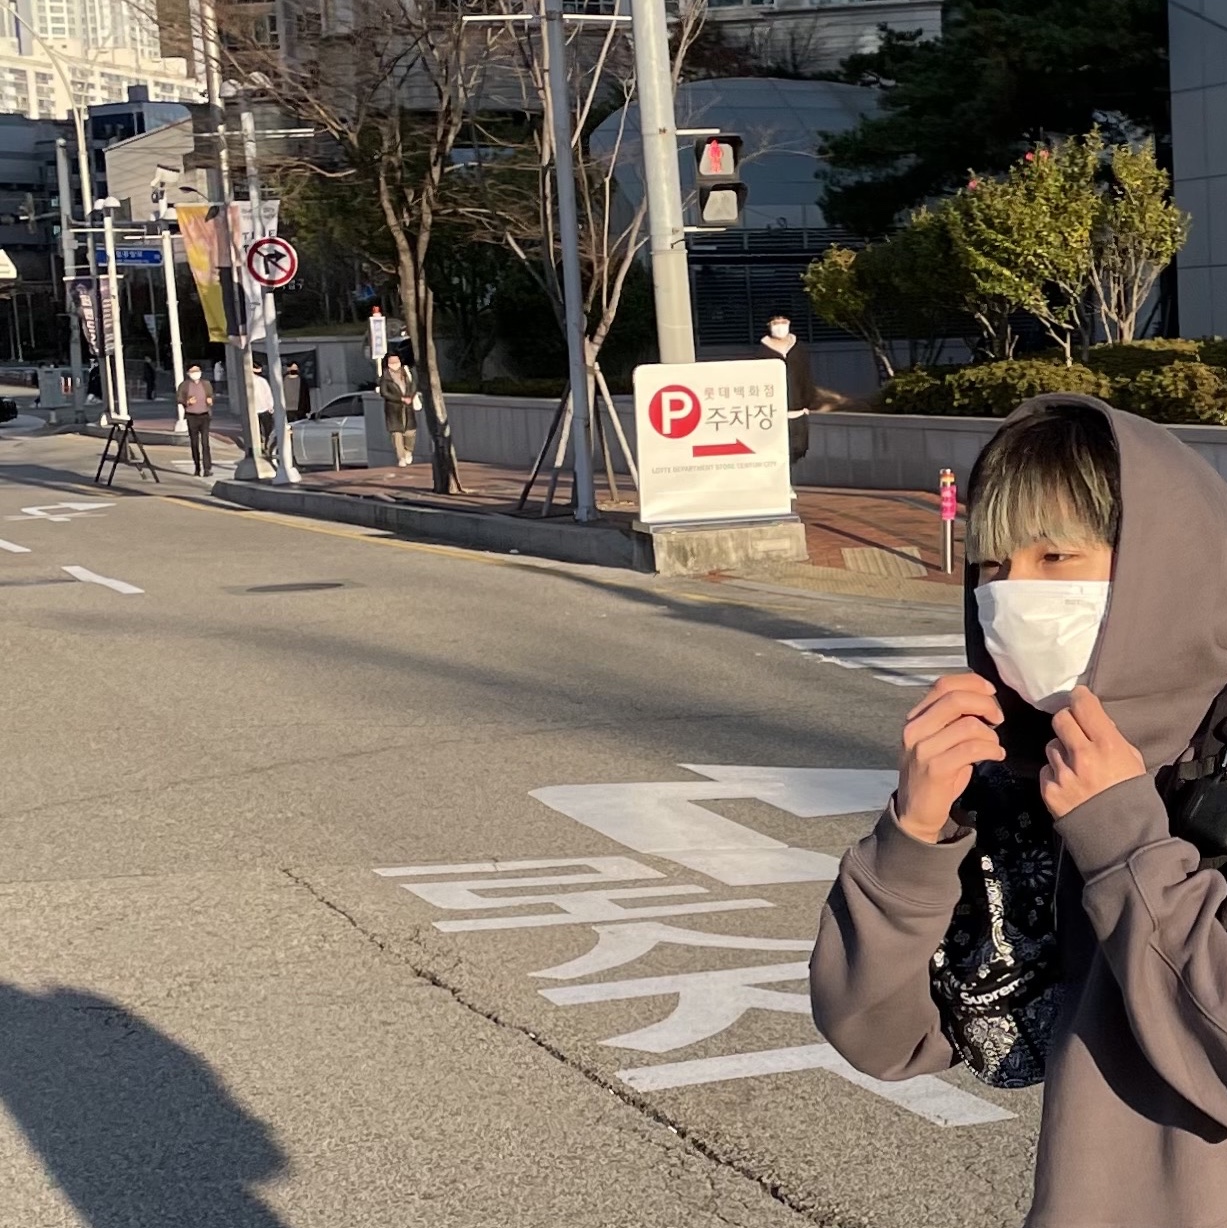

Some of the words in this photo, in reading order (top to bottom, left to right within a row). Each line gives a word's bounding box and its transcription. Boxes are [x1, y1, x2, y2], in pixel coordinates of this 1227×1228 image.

[661, 391, 694, 435] P
[704, 404, 778, 432] 주차장
[960, 970, 1035, 1006] Supreme
